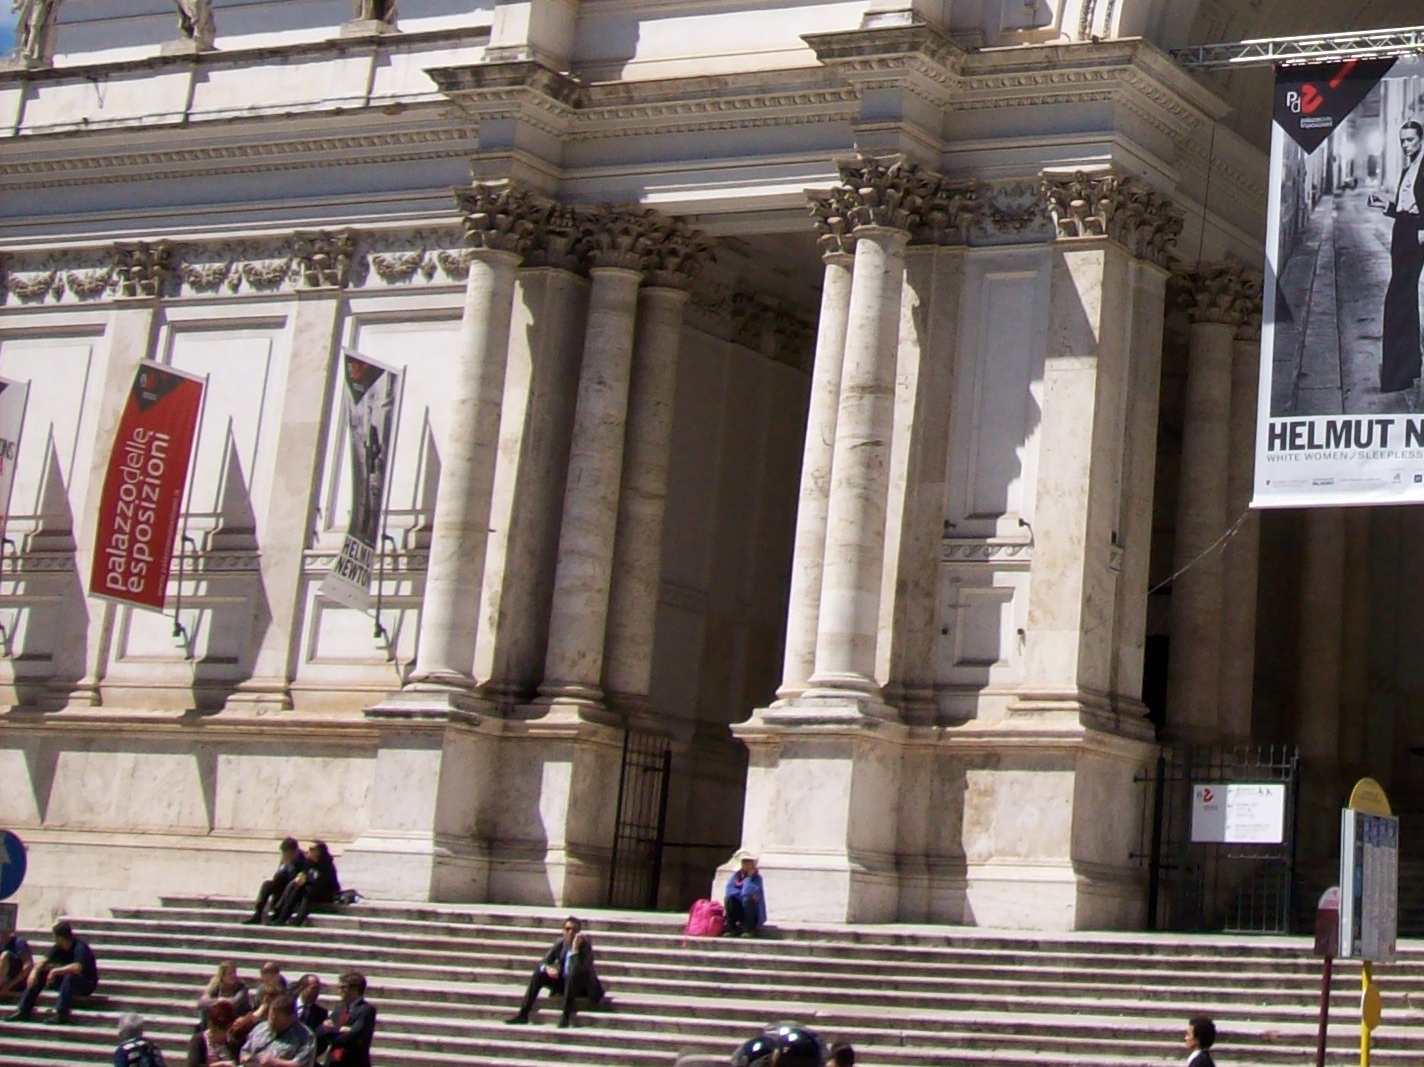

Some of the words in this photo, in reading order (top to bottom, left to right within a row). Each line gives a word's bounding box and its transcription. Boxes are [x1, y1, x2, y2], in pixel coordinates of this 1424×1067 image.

[1267, 419, 1395, 452] HELMUT
[1266, 452, 1300, 462] WHITE
[127, 432, 171, 593] esposizioni
